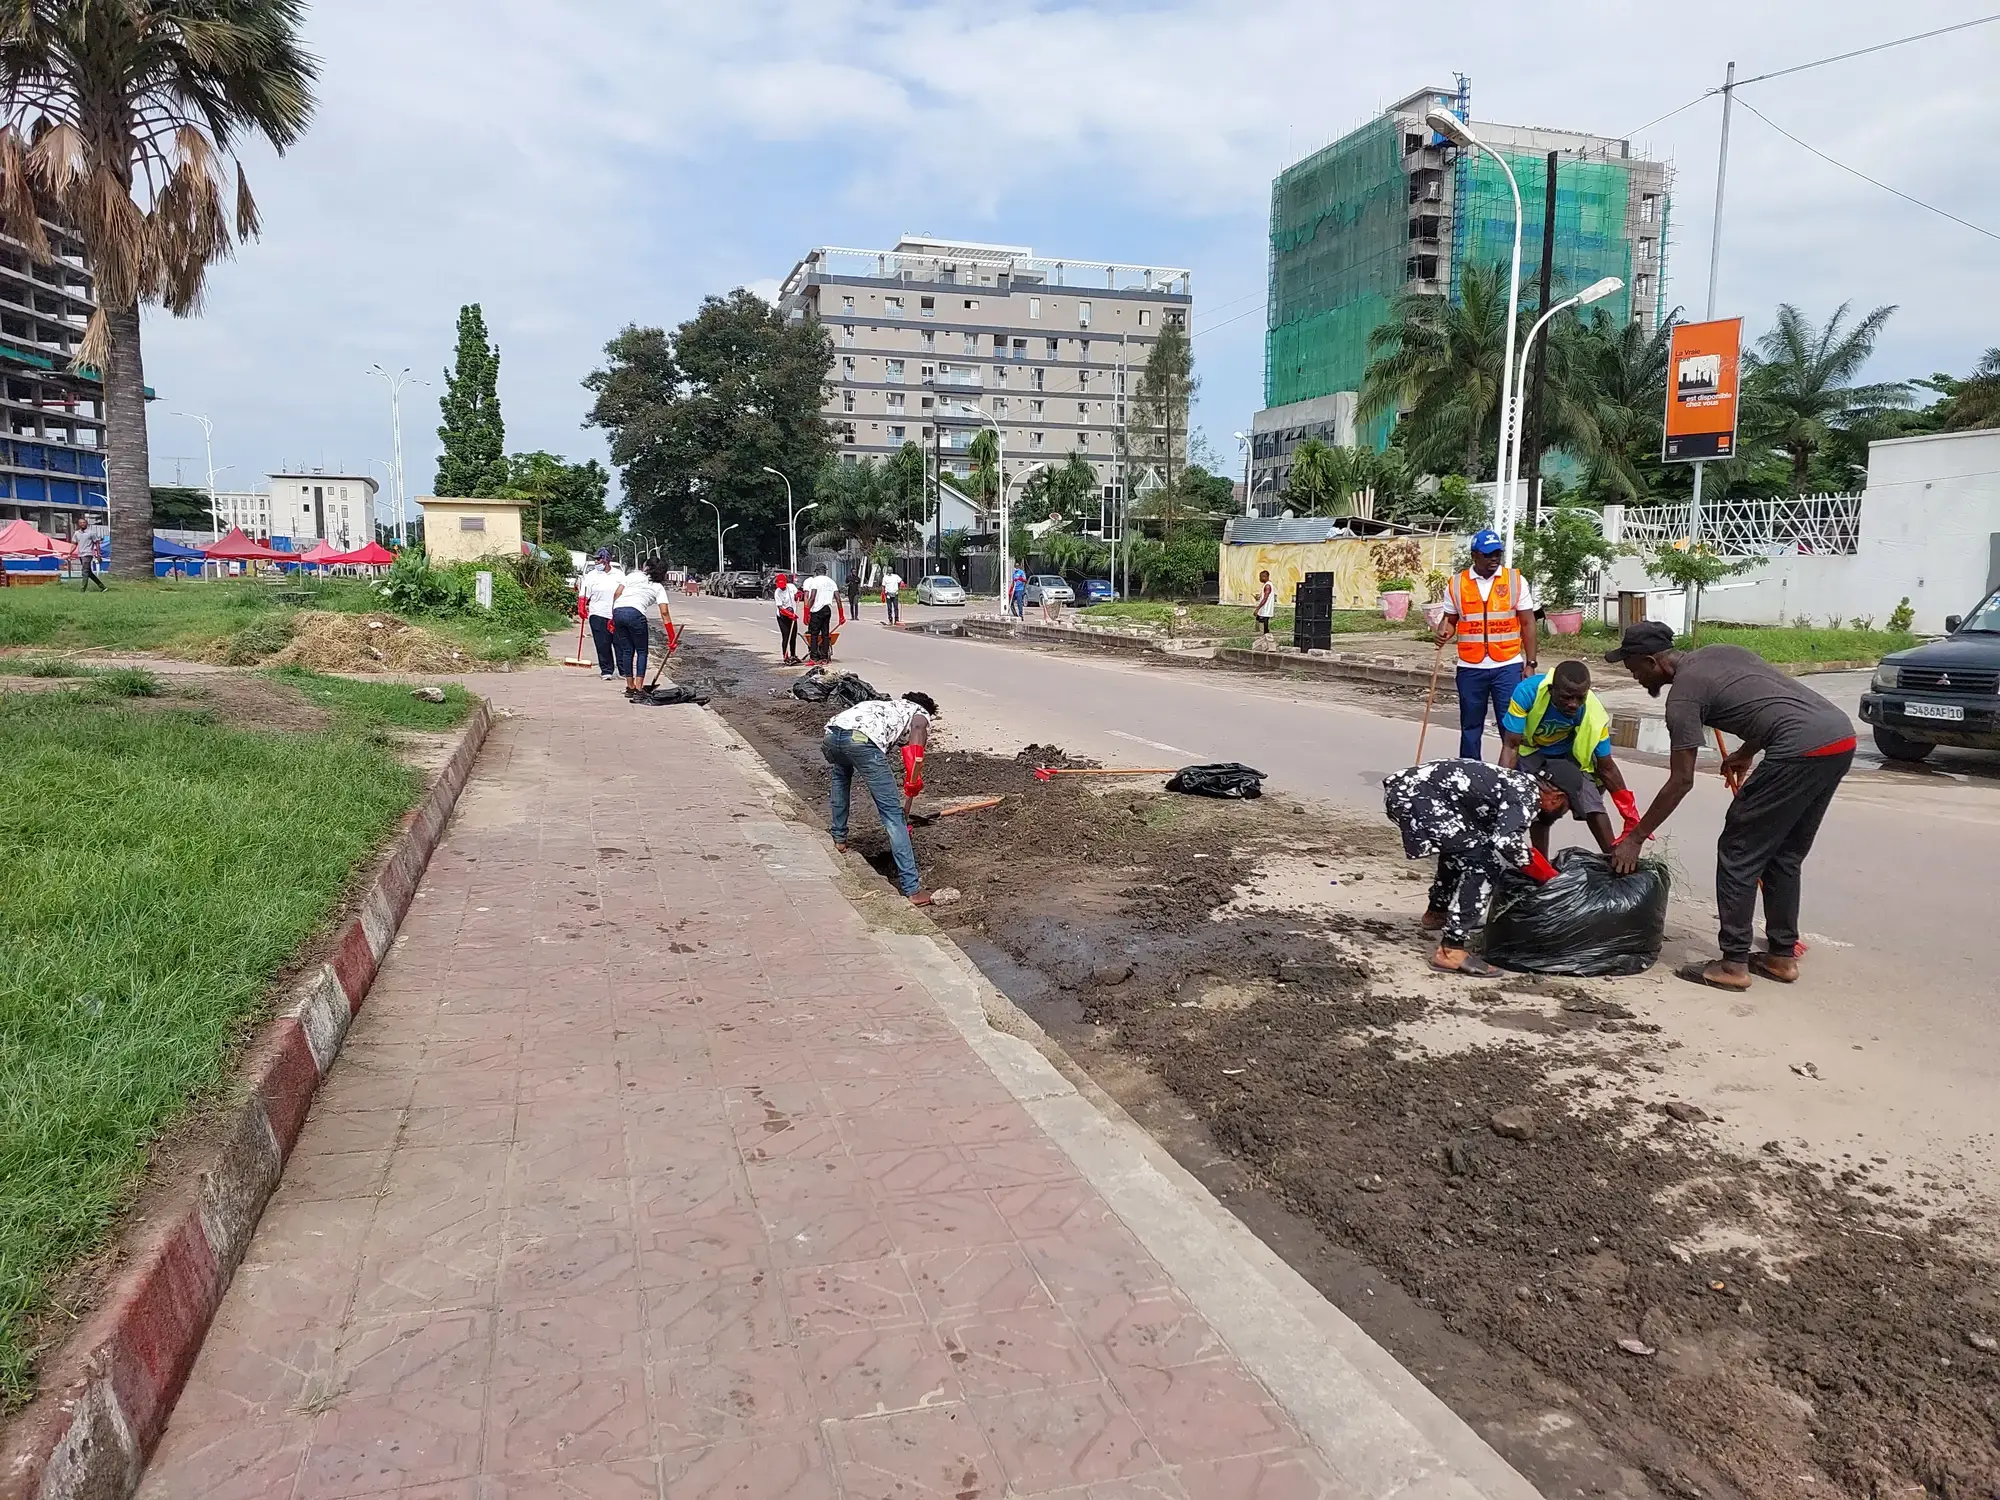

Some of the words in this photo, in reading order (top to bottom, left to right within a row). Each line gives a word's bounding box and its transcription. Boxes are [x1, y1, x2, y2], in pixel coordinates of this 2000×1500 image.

[1684, 348, 1701, 356] Vraie
[1697, 392, 1732, 401] disponible
[1912, 706, 1947, 717] 5486AF
[1950, 709, 1963, 719] 10
